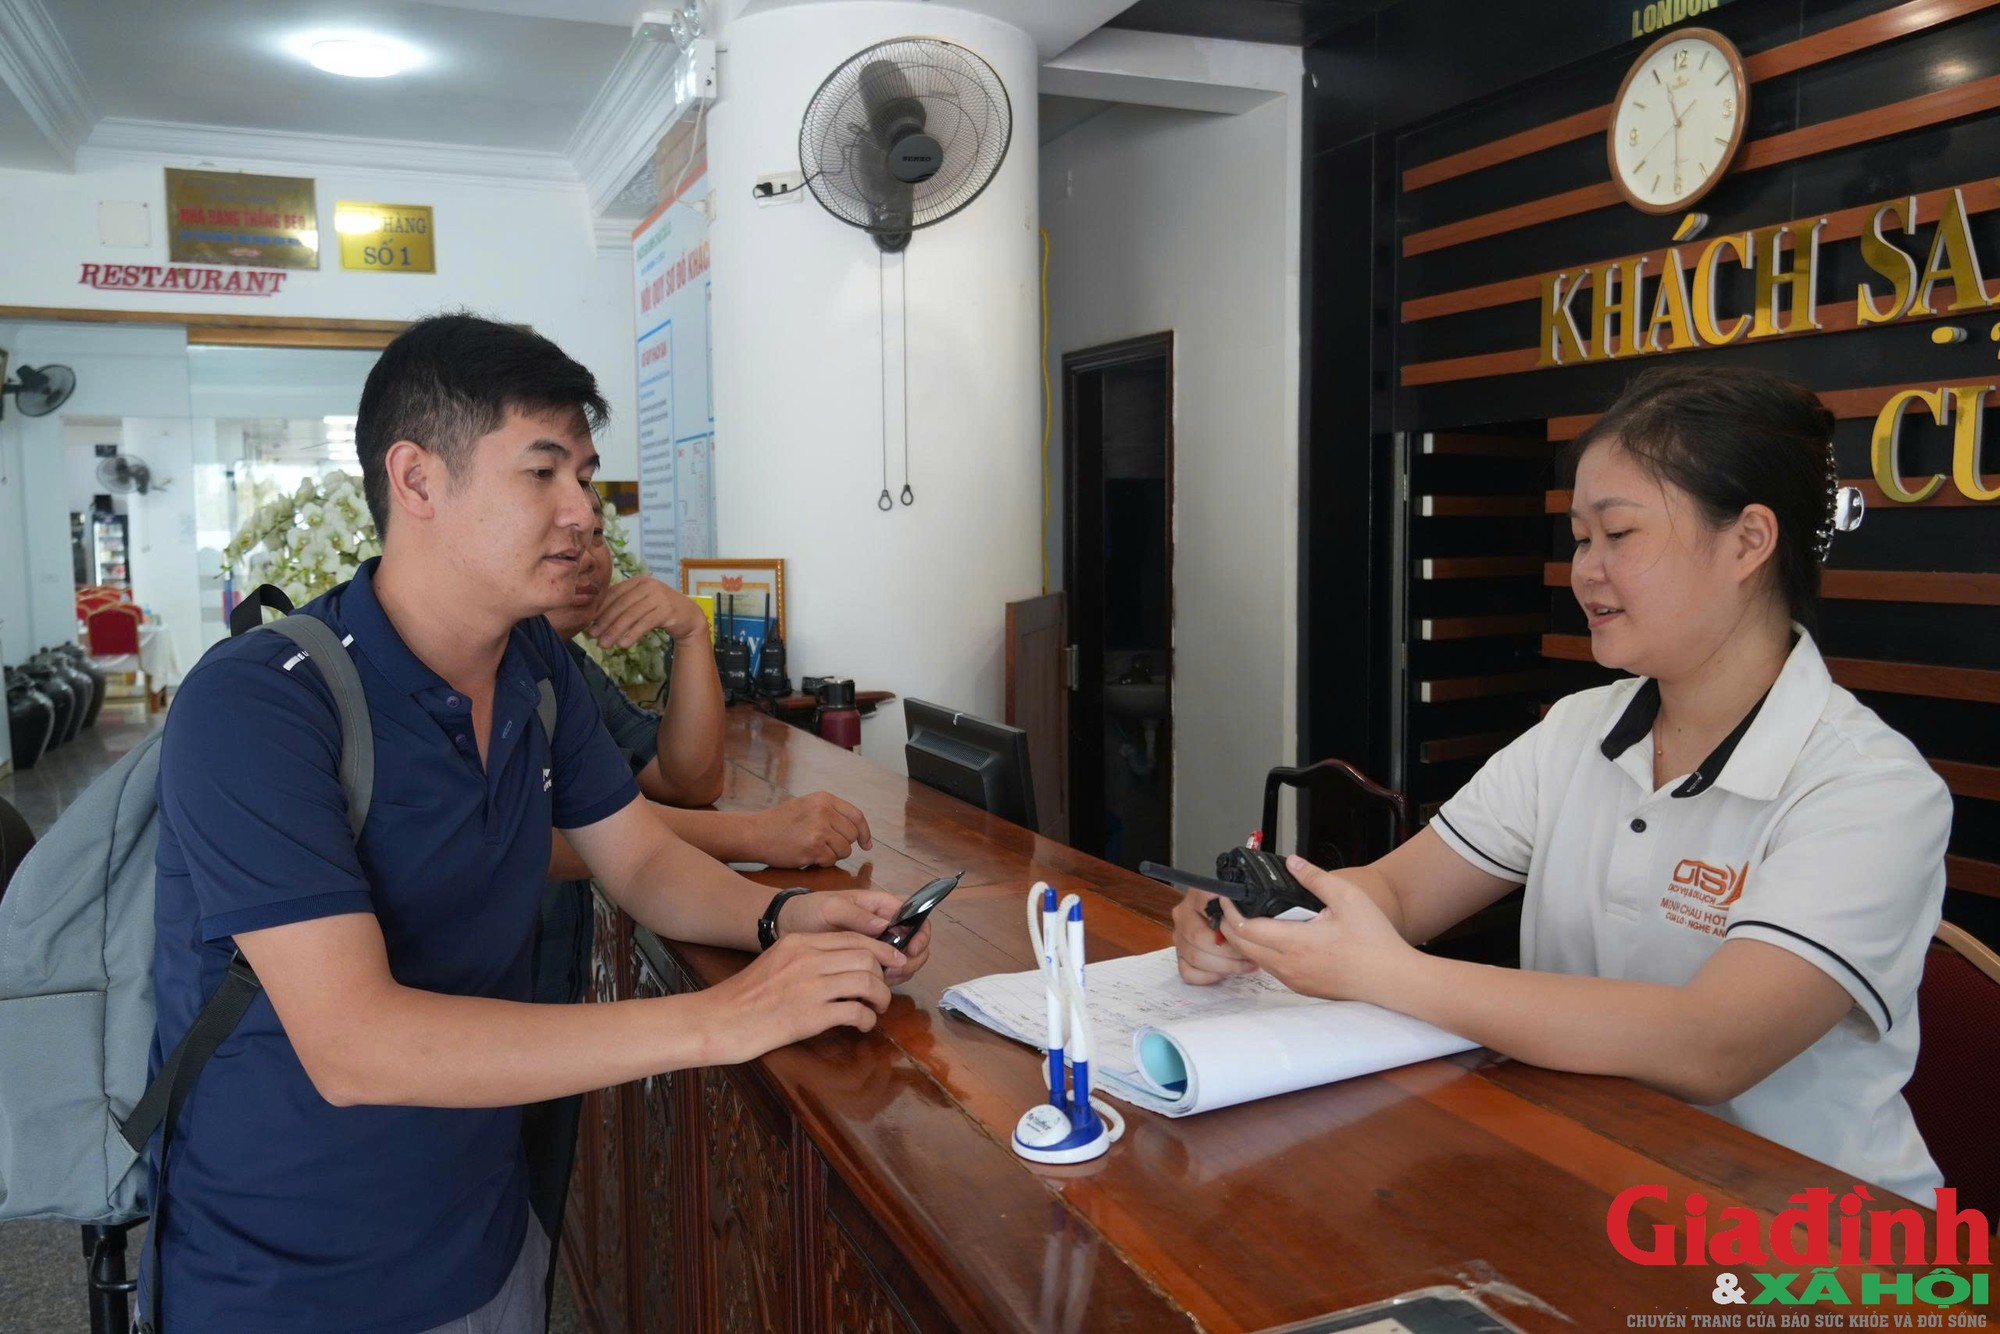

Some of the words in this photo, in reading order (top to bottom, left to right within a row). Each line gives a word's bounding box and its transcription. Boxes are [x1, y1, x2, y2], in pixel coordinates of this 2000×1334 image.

[1673, 49, 1689, 72] 12
[1629, 127, 1639, 147] 9
[1722, 97, 1734, 120] 3
[384, 212, 426, 234] HÀNG
[364, 238, 394, 266] SỐ
[401, 246, 411, 266] 1
[78, 263, 287, 297] RESTAURANT
[1537, 213, 1827, 366] KHÁCH
[1857, 189, 2000, 345] SẠ
